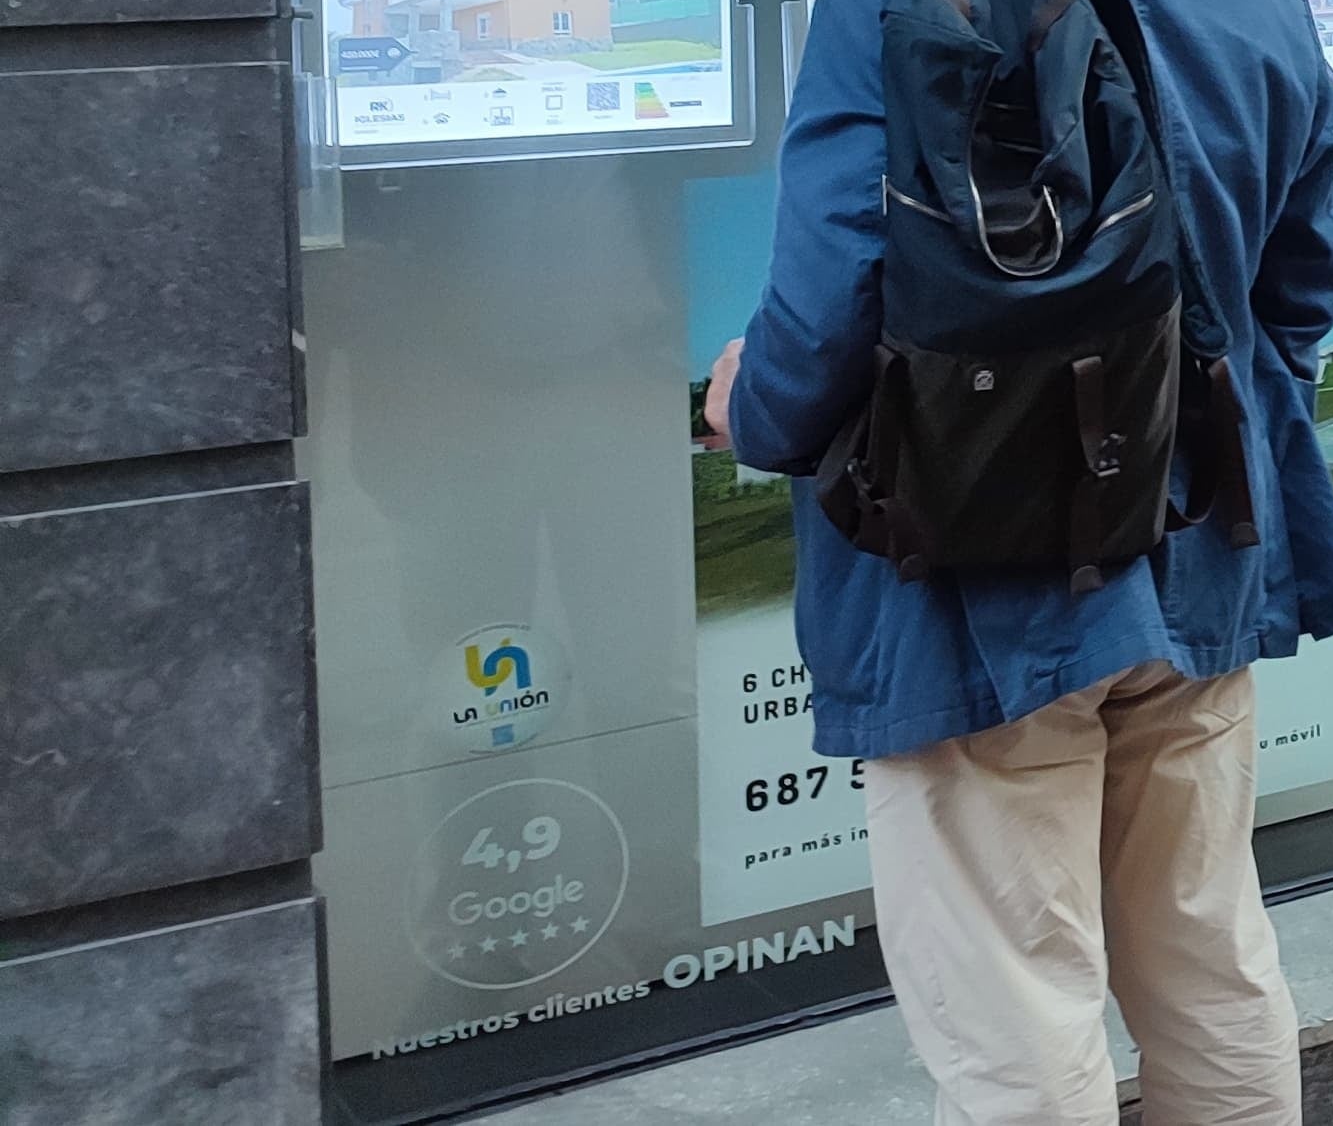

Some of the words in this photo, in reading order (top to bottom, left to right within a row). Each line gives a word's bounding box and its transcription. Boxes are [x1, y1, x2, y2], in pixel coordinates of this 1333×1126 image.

[743, 673, 758, 693] 6
[771, 663, 806, 688] CH
[744, 692, 814, 724] URBA
[1275, 724, 1322, 748] móvil
[745, 766, 829, 812] 687
[850, 758, 865, 790] 5
[461, 814, 562, 874] 4,9
[745, 845, 793, 870] para
[802, 833, 843, 853] más
[447, 874, 585, 927] Google
[371, 1008, 521, 1061] Nuestros
[527, 977, 652, 1026] clientes
[662, 914, 857, 991] OPINAN
